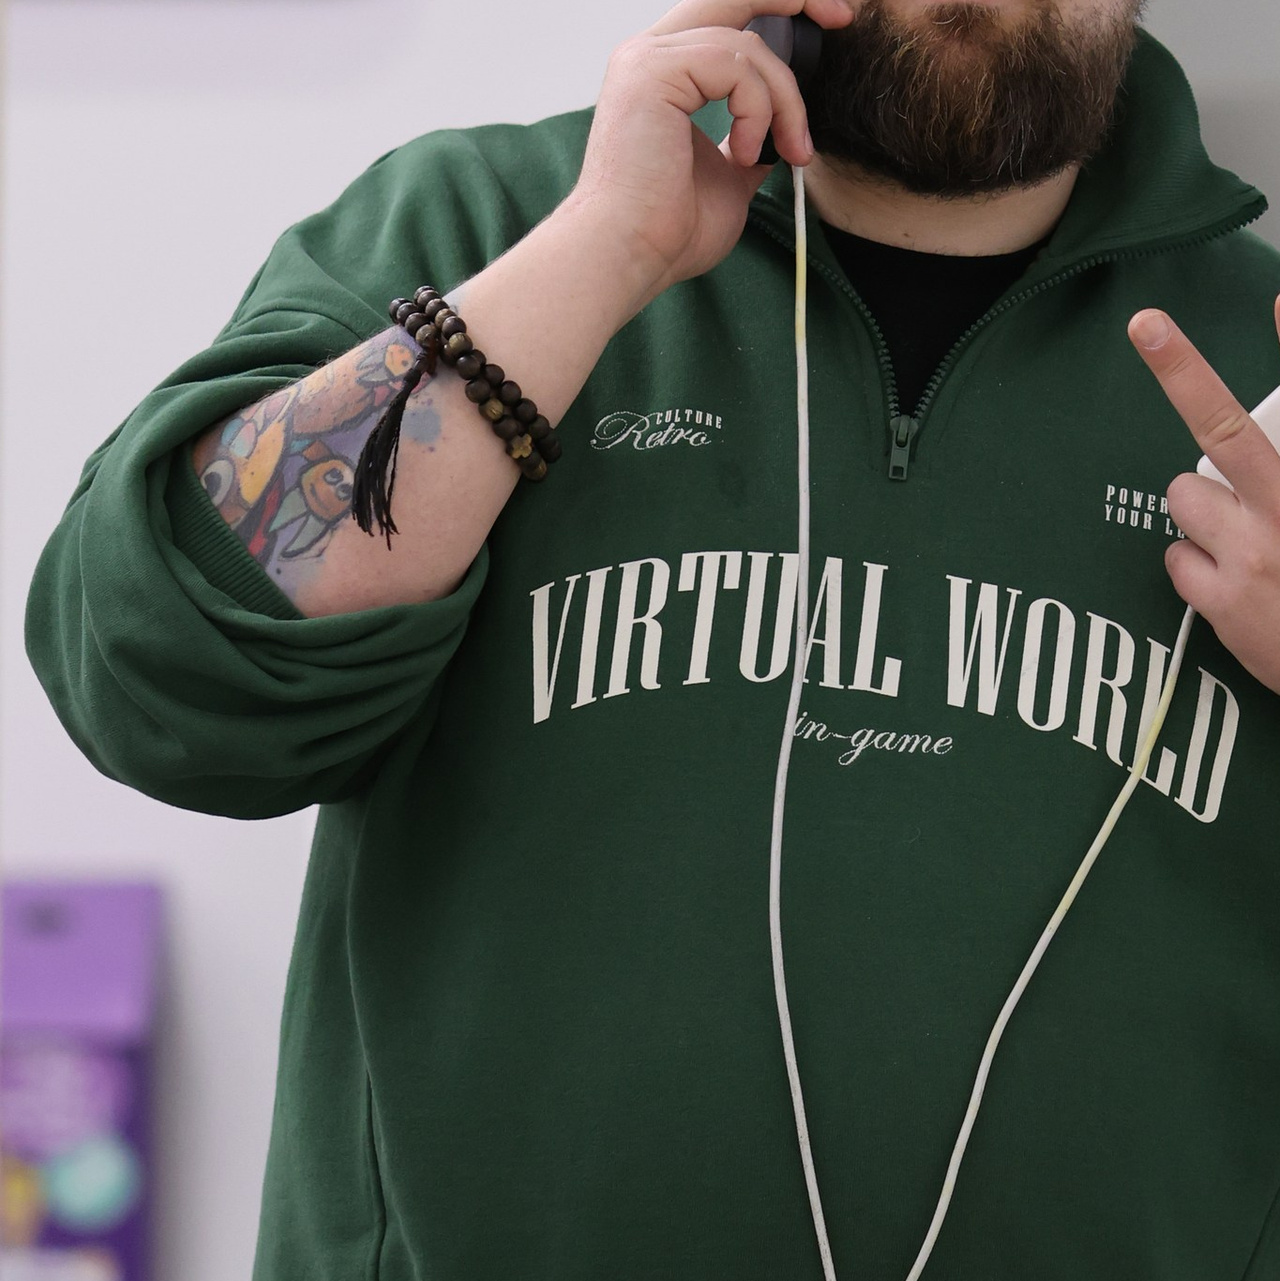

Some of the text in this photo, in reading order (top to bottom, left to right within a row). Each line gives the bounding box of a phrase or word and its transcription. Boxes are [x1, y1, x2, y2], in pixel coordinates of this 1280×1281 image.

[590, 411, 712, 450] Retro
[655, 408, 723, 430] CULTURE
[1104, 504, 1153, 530] YOUR
[529, 551, 1240, 824] VIRTUAL WORLD
[793, 711, 953, 766] in-game
